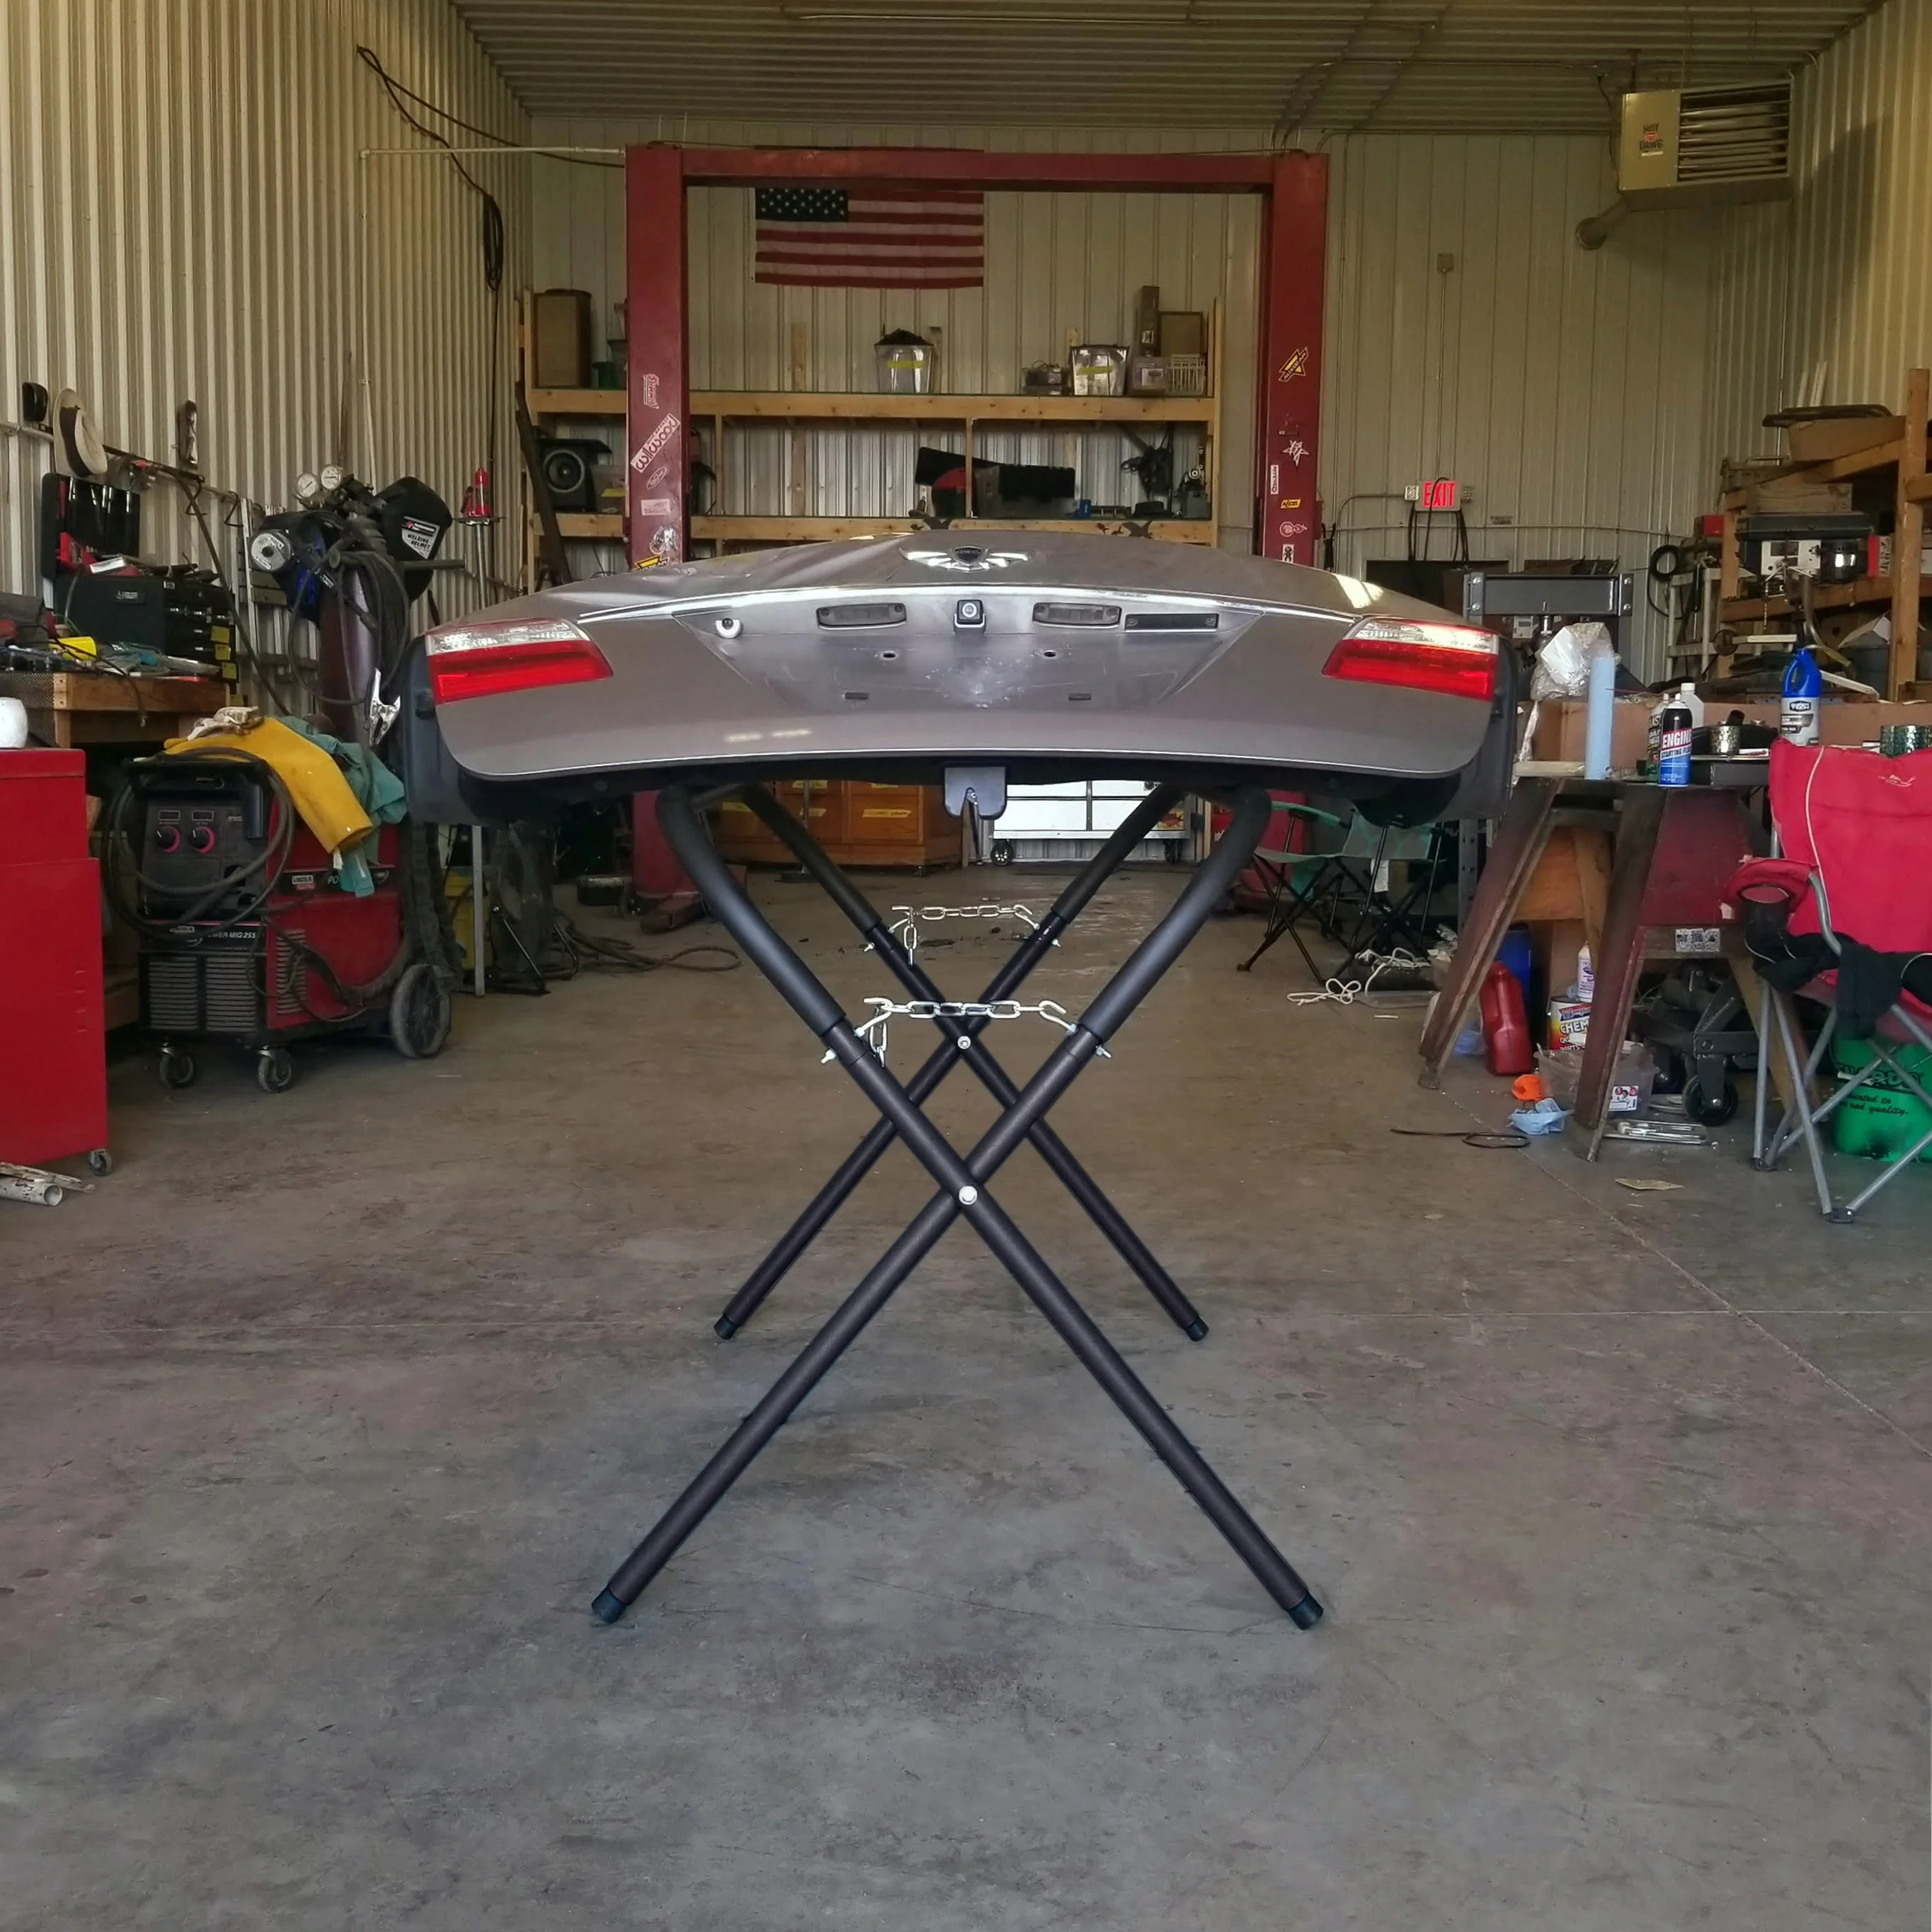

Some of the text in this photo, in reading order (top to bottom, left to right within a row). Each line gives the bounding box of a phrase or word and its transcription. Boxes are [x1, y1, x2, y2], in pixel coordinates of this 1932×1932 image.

[635, 413, 679, 471] wilwood
[1423, 482, 1456, 506] EXIT
[407, 534, 430, 544] WELDING
[411, 540, 431, 549] HELMET
